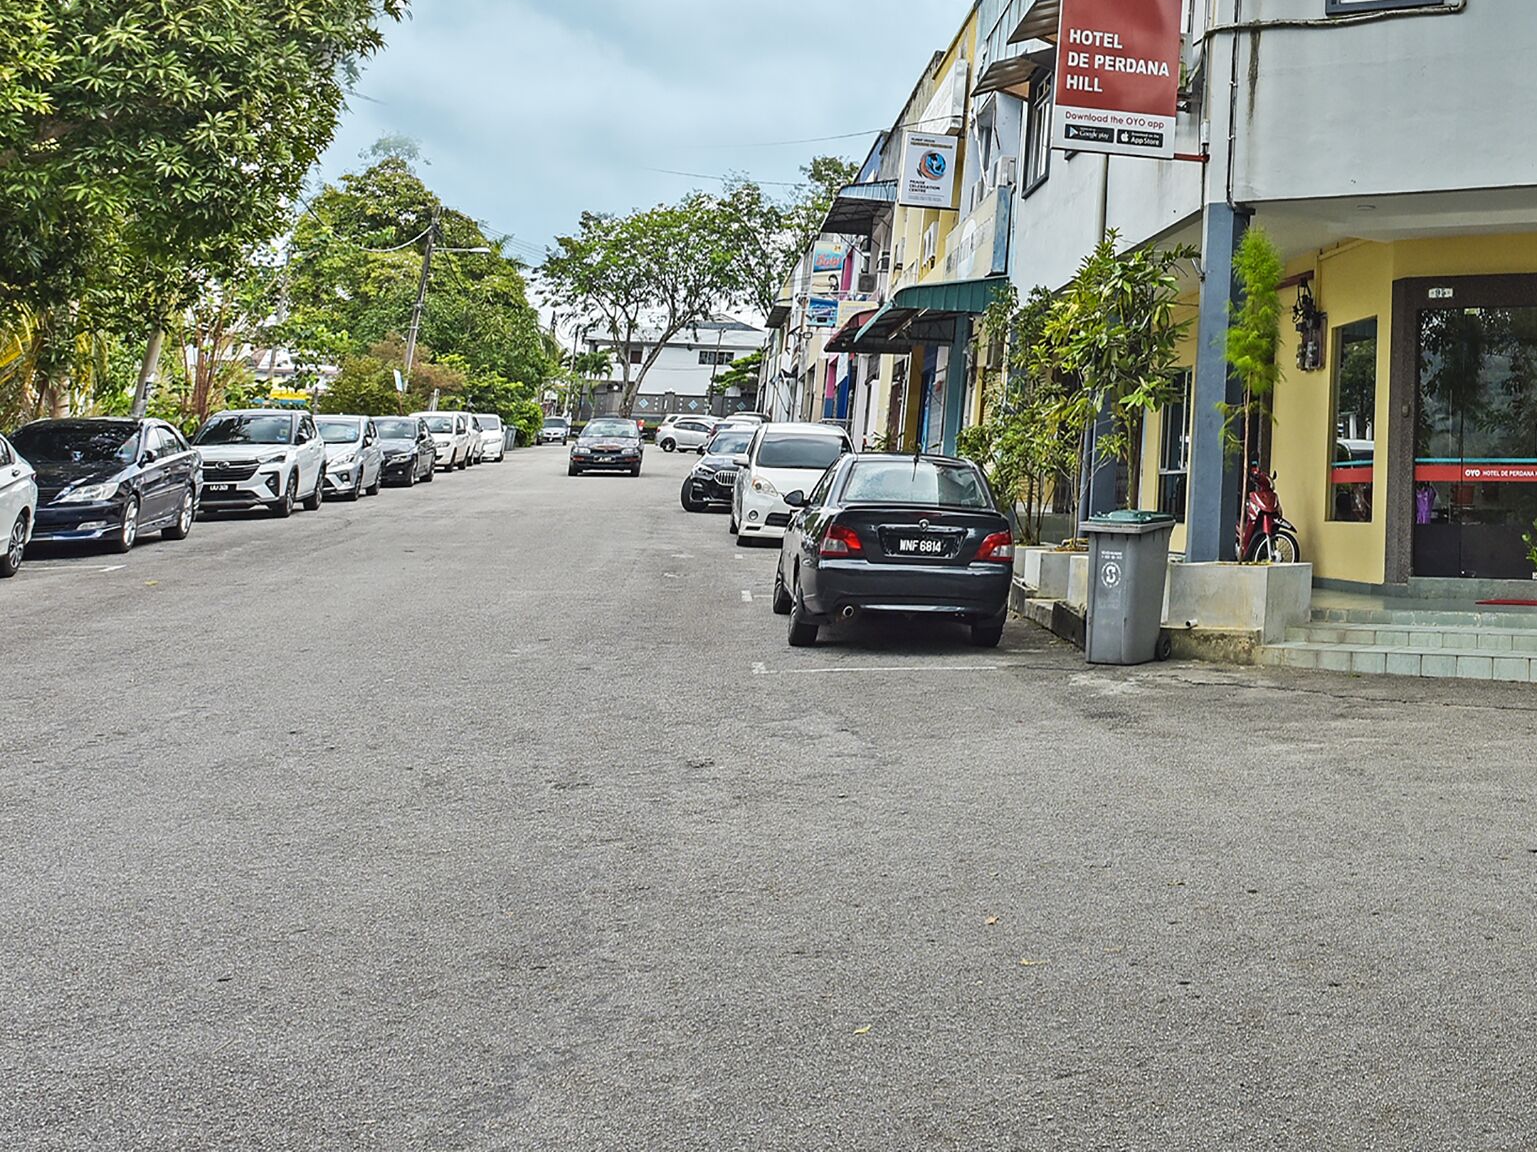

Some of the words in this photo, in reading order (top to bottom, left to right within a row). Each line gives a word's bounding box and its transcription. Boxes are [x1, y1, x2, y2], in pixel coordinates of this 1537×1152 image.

[1069, 28, 1123, 49] HOTEL
[1067, 51, 1089, 68] DE
[1094, 54, 1170, 77] PERDANA
[1066, 74, 1103, 92] HILL
[1065, 111, 1108, 123] Download
[1110, 115, 1124, 125] the
[1126, 116, 1146, 127] OYO
[1147, 120, 1165, 129] app
[1465, 469, 1480, 477] OYO
[900, 539, 919, 552] WNF
[919, 540, 941, 553] 6814
